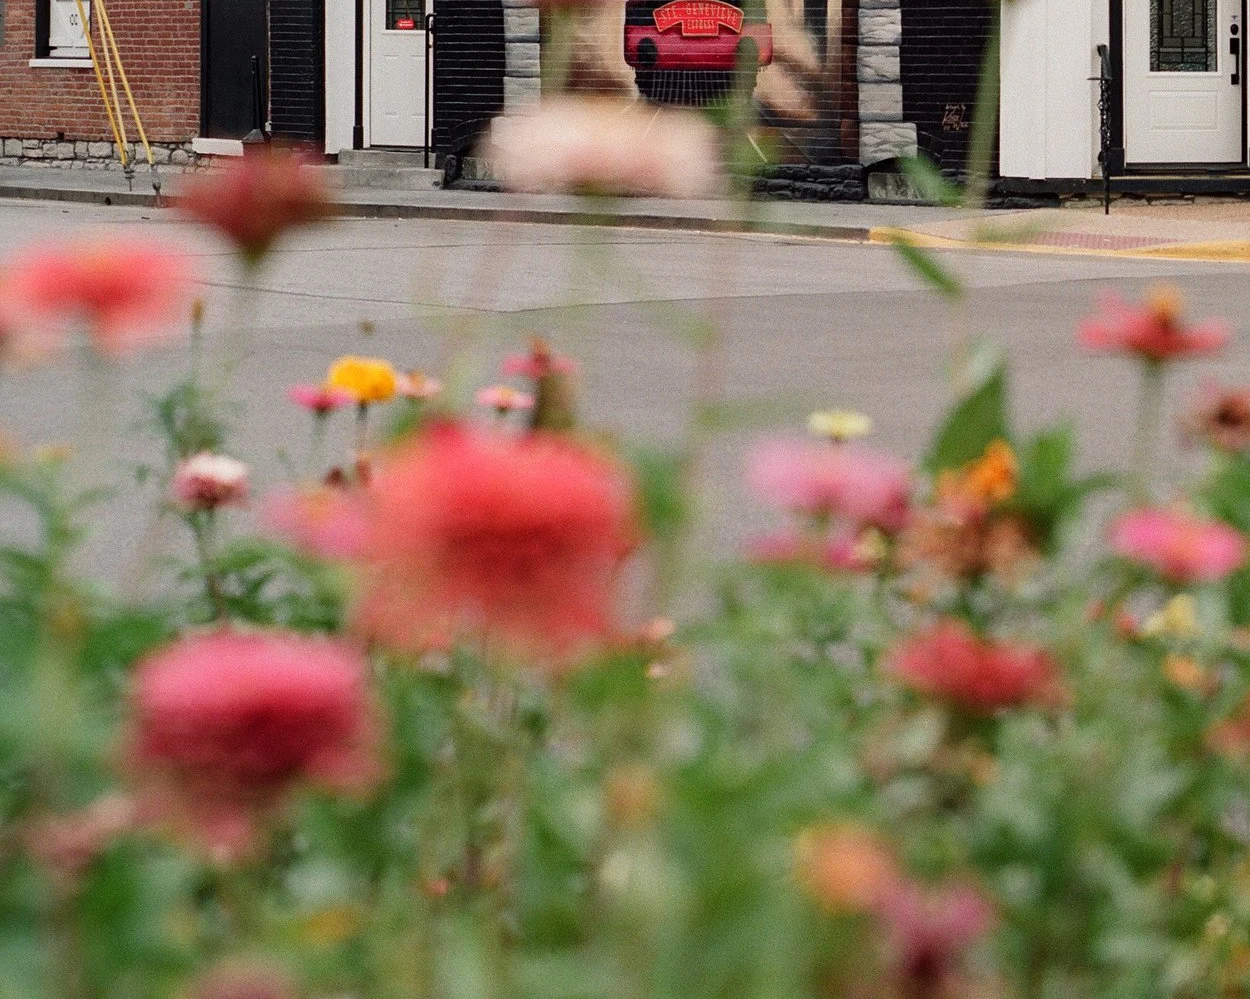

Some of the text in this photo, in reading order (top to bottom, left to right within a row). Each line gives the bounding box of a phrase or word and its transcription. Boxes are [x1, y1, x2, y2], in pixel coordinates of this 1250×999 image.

[660, 2, 738, 26] STE. GENEVIEVE
[687, 19, 715, 30] EXPRESS
